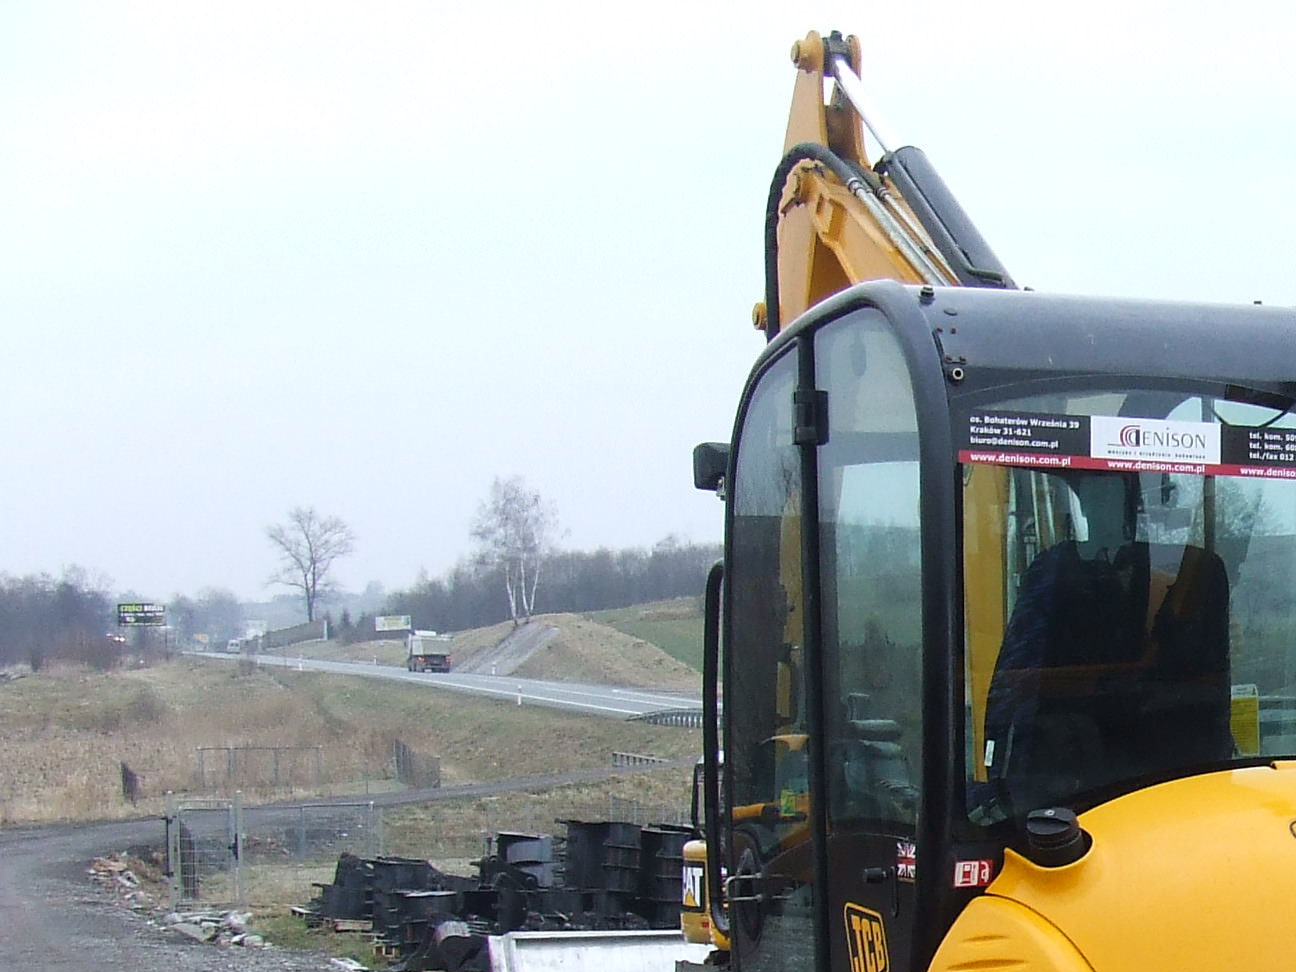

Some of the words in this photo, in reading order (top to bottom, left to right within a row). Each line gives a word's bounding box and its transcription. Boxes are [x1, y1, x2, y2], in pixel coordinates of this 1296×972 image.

[970, 426, 1001, 435] Kraków
[970, 436, 1059, 449] biuro@denison.com.pl
[970, 453, 1071, 467] www.denison.com.pl
[1107, 461, 1206, 473] www.denison.com.pl
